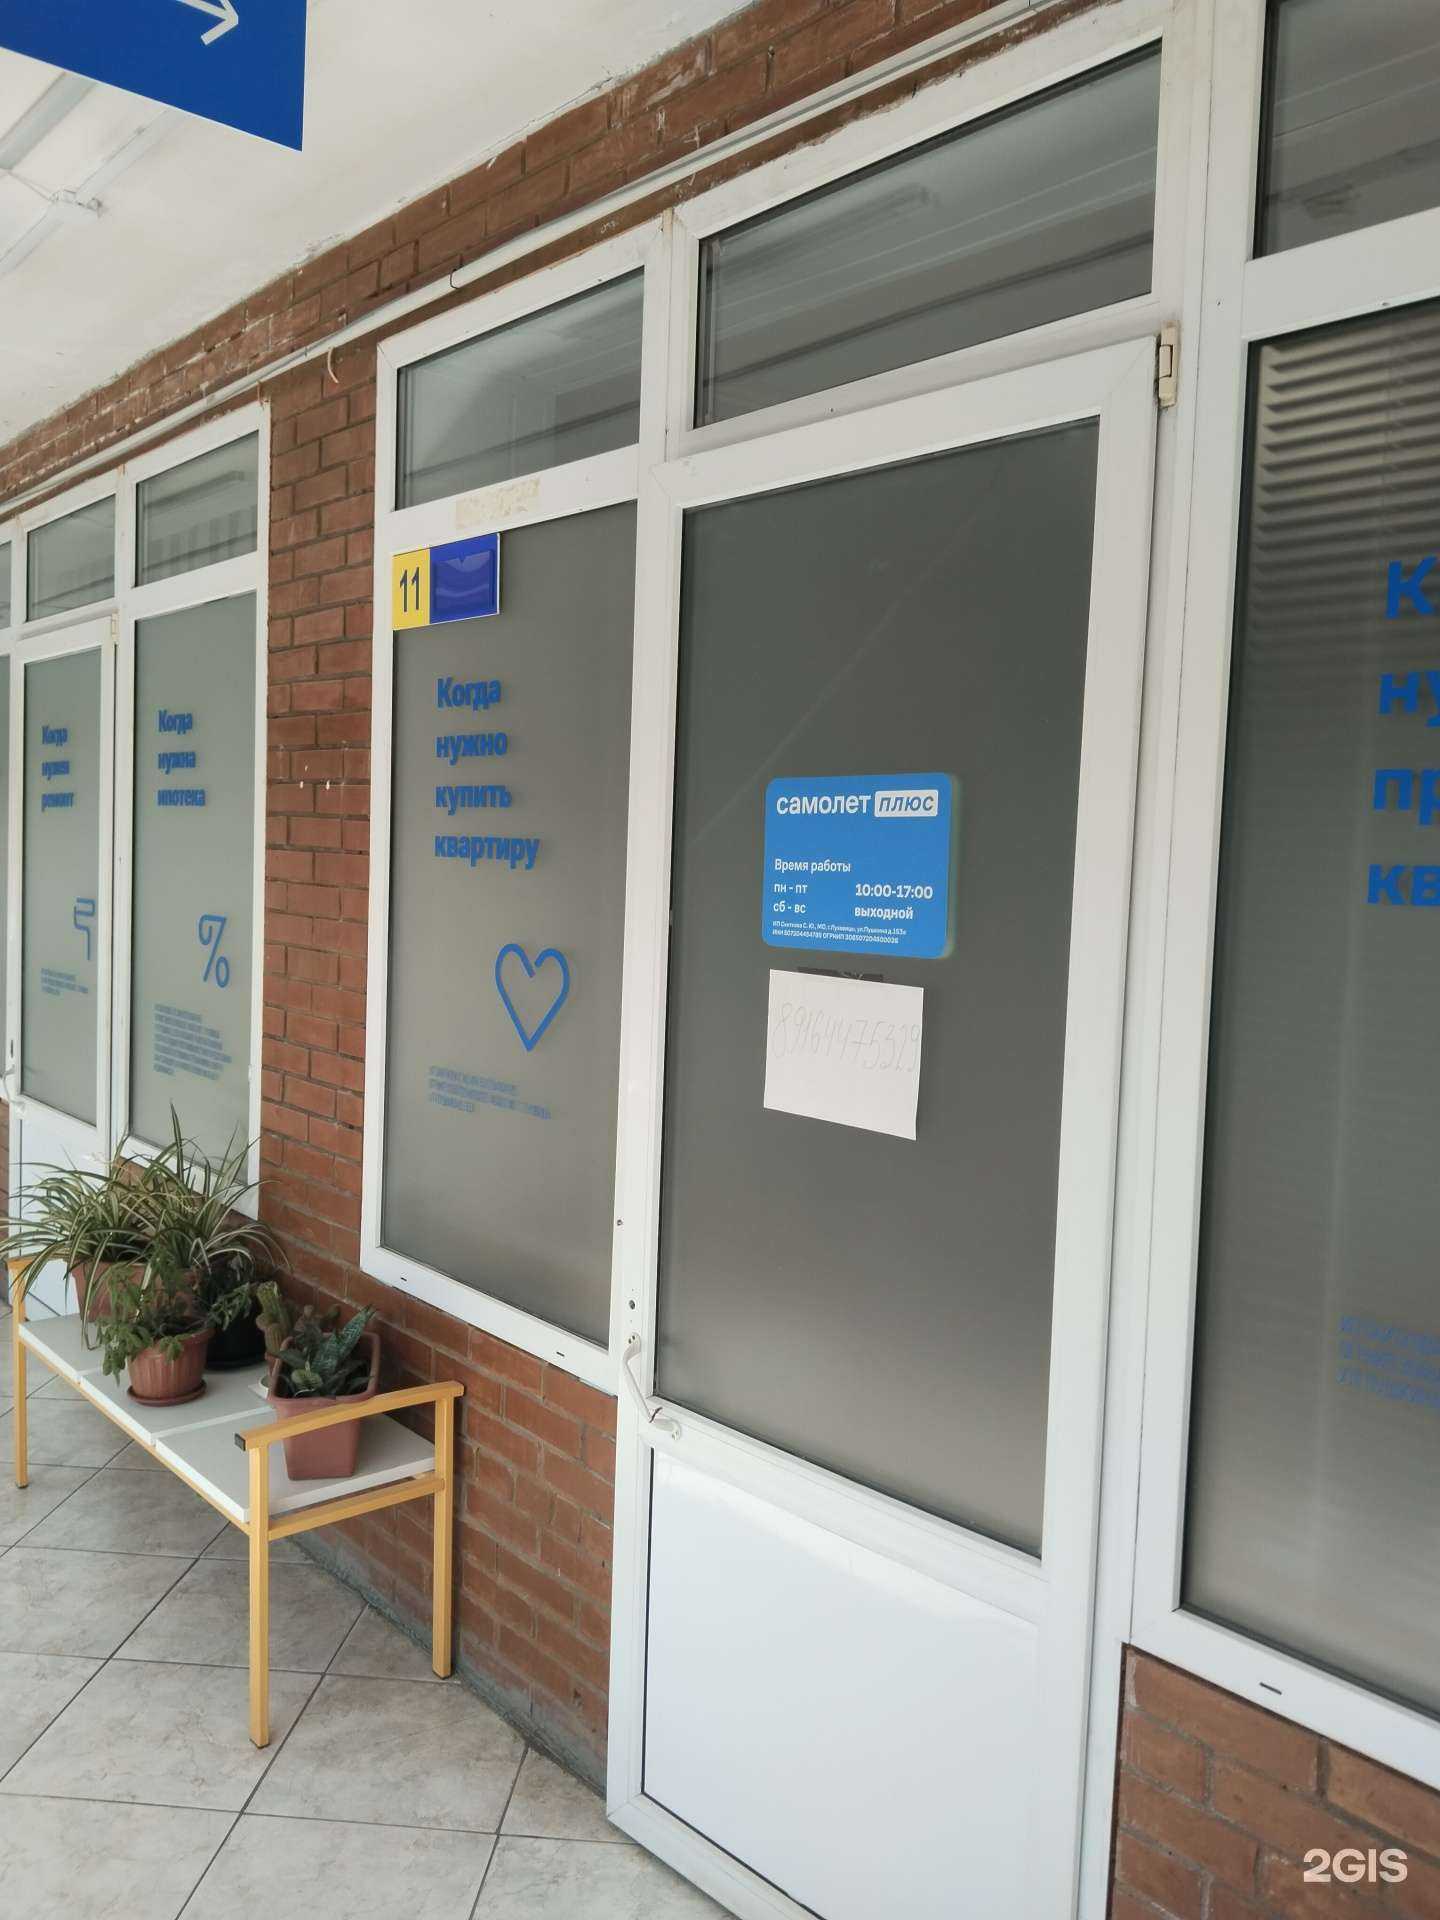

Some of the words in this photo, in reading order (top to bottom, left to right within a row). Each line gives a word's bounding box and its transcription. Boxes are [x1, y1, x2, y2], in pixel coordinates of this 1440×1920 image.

[399, 567, 421, 613] 11
[437, 676, 502, 712] Когда
[158, 709, 193, 735] Когда
[436, 731, 508, 765] нужно
[158, 751, 196, 775] нужна
[157, 789, 206, 807] ипотека
[435, 784, 512, 815] купить
[776, 795, 872, 815] самолет
[434, 835, 540, 871] квартиру
[774, 858, 809, 873] Время
[811, 859, 851, 874] работы
[774, 884, 787, 894] пн
[795, 885, 807, 895] пт
[855, 883, 933, 900] 10:00-17:00
[773, 901, 785, 913] сб
[794, 904, 806, 914] вс
[854, 905, 913, 921] выходной
